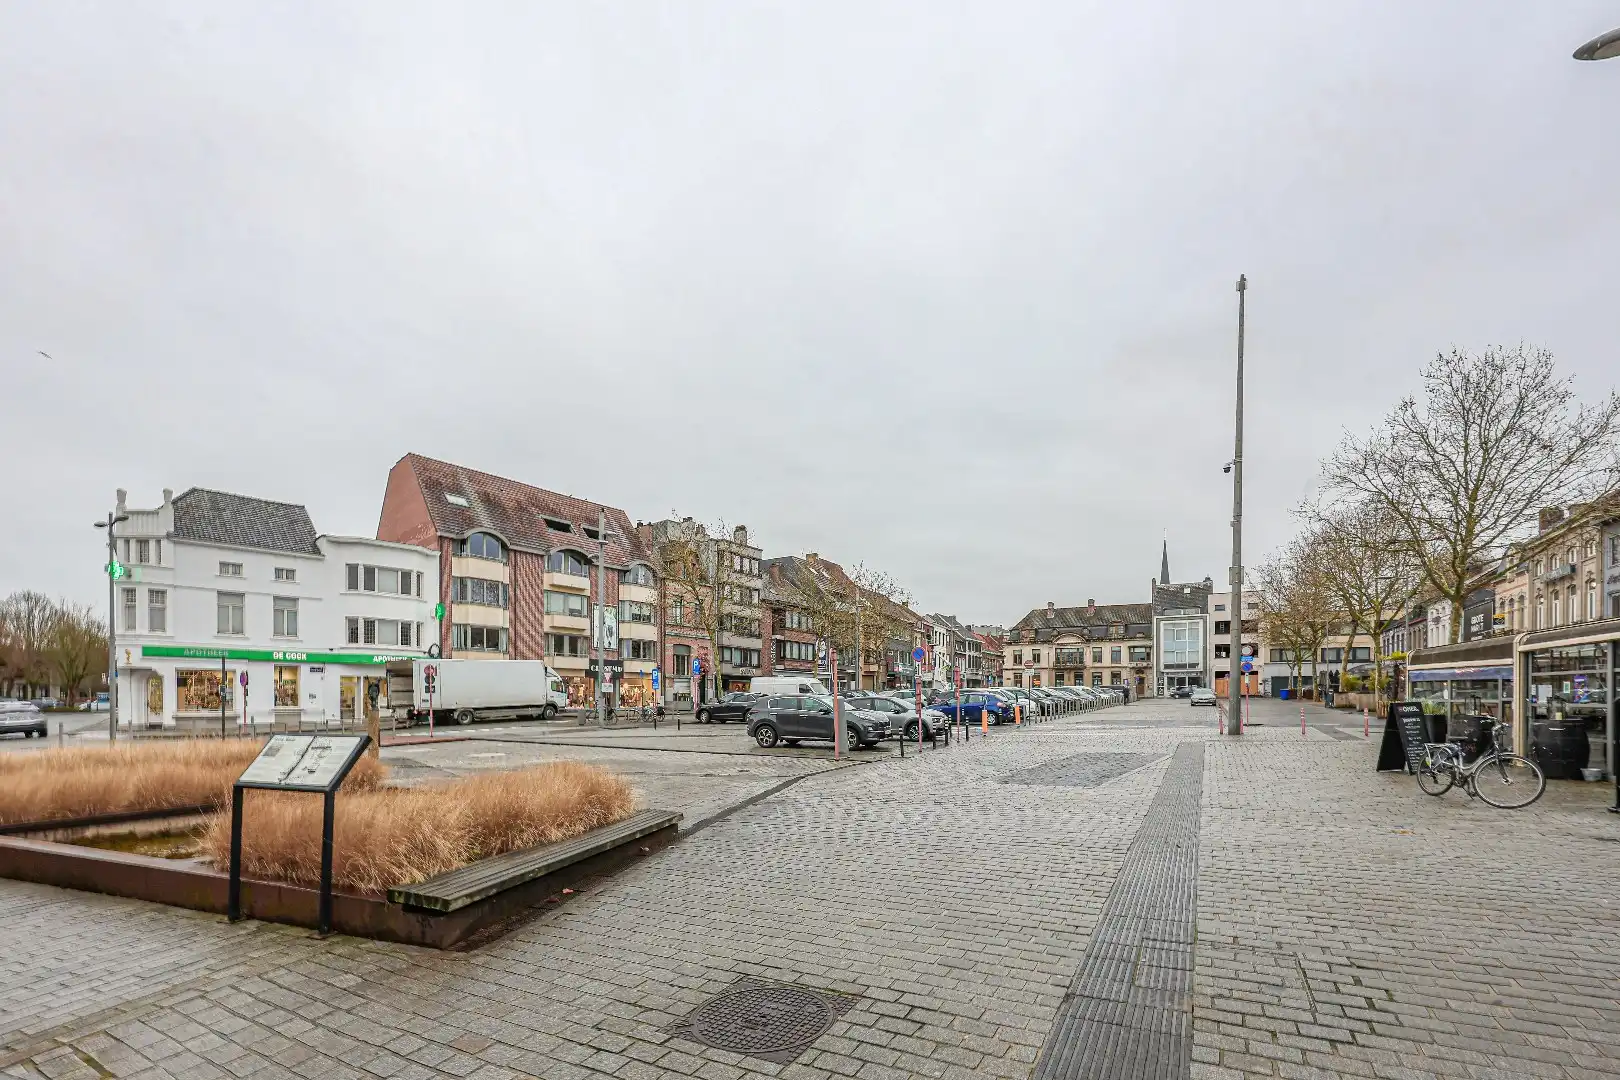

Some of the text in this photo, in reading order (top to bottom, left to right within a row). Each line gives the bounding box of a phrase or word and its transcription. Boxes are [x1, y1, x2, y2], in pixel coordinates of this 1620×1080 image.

[183, 648, 229, 657] APOTHEEK
[273, 651, 284, 660] DE
[693, 660, 699, 670] P
[652, 670, 658, 680] P
